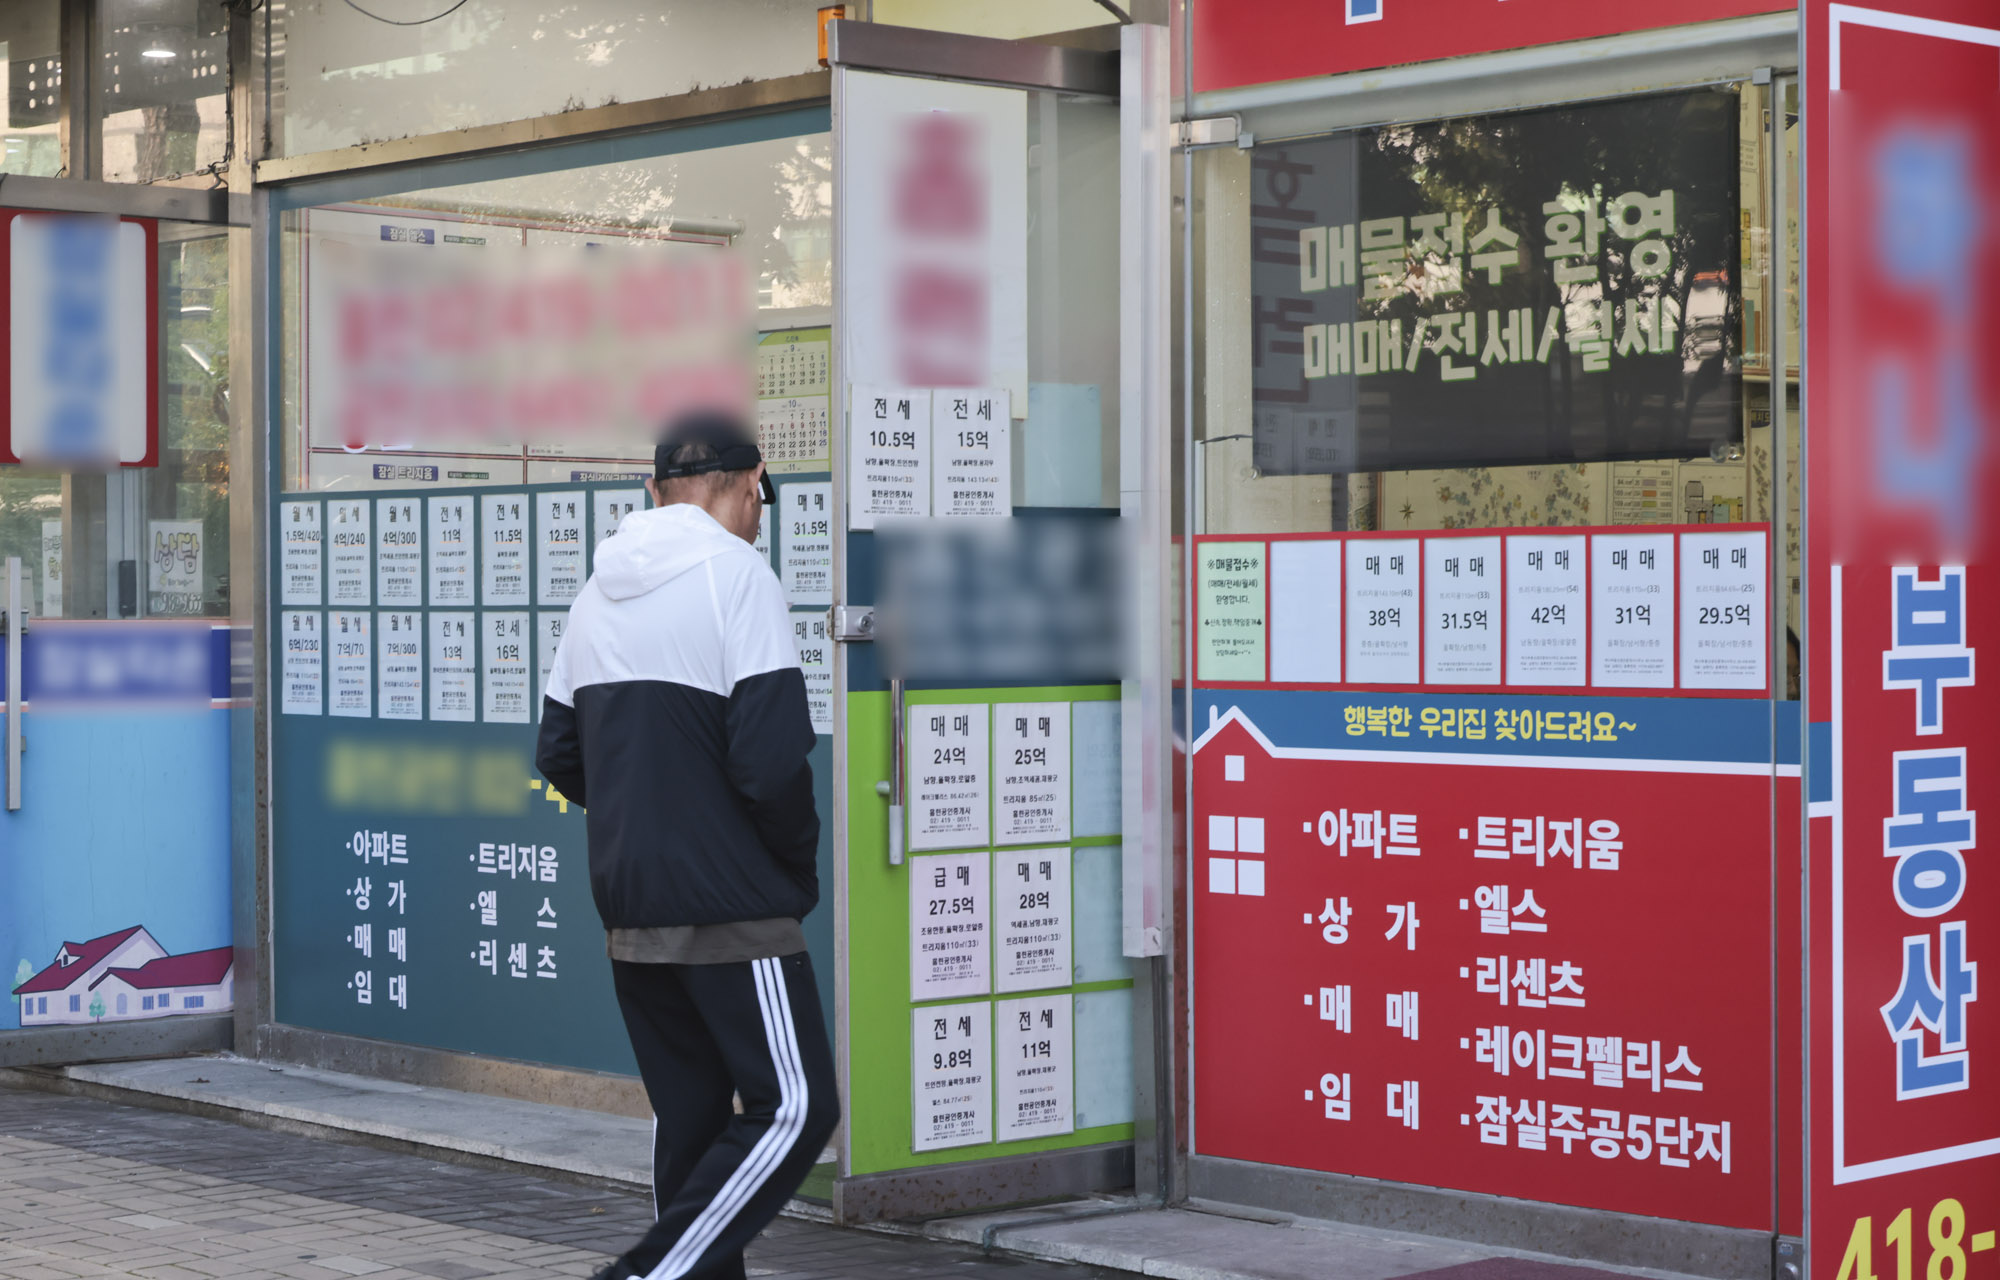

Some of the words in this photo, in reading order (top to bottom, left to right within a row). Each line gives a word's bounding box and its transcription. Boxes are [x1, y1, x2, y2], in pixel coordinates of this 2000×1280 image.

[1300, 207, 1520, 299] 매물접수
[1541, 188, 1676, 286] 환영
[1303, 295, 1677, 380] 매매/전세/월세
[789, 400, 797, 408] 10
[789, 431, 797, 439] 15
[809, 430, 816, 438] 17
[870, 431, 914, 449] 10.5억
[958, 431, 988, 449] 15억
[779, 441, 786, 449] 21
[799, 440, 806, 448] 23
[378, 466, 395, 479] 잠실
[397, 466, 433, 480] 트리지움
[789, 463, 795, 471] 11
[286, 530, 321, 542] 1.5억/420
[383, 531, 416, 545] 4억/300
[443, 529, 460, 542] 11억
[494, 529, 522, 543] 11.5억
[550, 529, 578, 542] 12.5억
[794, 521, 827, 536] 31.5억
[334, 533, 365, 546] 4억/240
[154, 531, 199, 574] 상담
[1369, 608, 1400, 627] 38억
[1442, 610, 1487, 630] 31.5억
[1531, 605, 1565, 624] 42억
[1616, 605, 1650, 625] 31억
[1699, 604, 1749, 625] 29.5억
[551, 620, 560, 637] 전
[289, 639, 318, 651] 6억/230
[338, 643, 364, 656] 7억/70
[387, 643, 416, 655] 7억/300
[443, 646, 462, 660] 13억
[497, 645, 518, 661] 16억
[1344, 705, 1412, 740] 행복한
[1419, 707, 1487, 741] 우리집
[1494, 708, 1637, 743] 찾아드려요~
[934, 747, 965, 765] 24억
[1015, 748, 1045, 765] 25억
[1318, 808, 1420, 859] 아파트
[1474, 816, 1623, 870] 트리지움
[1880, 565, 1977, 1102] 부동산
[353, 830, 408, 865] 아파트
[478, 843, 558, 882] 트리지움
[354, 877, 372, 910] 상
[388, 880, 406, 914] 가
[1020, 892, 1049, 909] 28억
[478, 891, 497, 926] 엘
[537, 898, 557, 928] 스
[930, 896, 973, 915] 27.5억
[1474, 885, 1547, 934] 엘스
[1318, 897, 1352, 944] 상
[1385, 902, 1420, 950] 가
[355, 924, 371, 958] 매
[389, 928, 406, 962] 매
[355, 971, 371, 1004] 임
[389, 975, 406, 1009] 대
[1477, 955, 1585, 1008] 리센츠
[1320, 985, 1351, 1033] 매
[1386, 991, 1418, 1040] 매
[1022, 1040, 1050, 1058] 11억
[934, 1049, 971, 1069] 9.8억
[1476, 1026, 1703, 1092] 레이크펠리스
[1320, 1073, 1350, 1121] 임
[1387, 1081, 1419, 1130] 대
[1475, 1096, 1730, 1173] 잠실주공5단지
[1836, 1197, 1996, 1280] 418-
